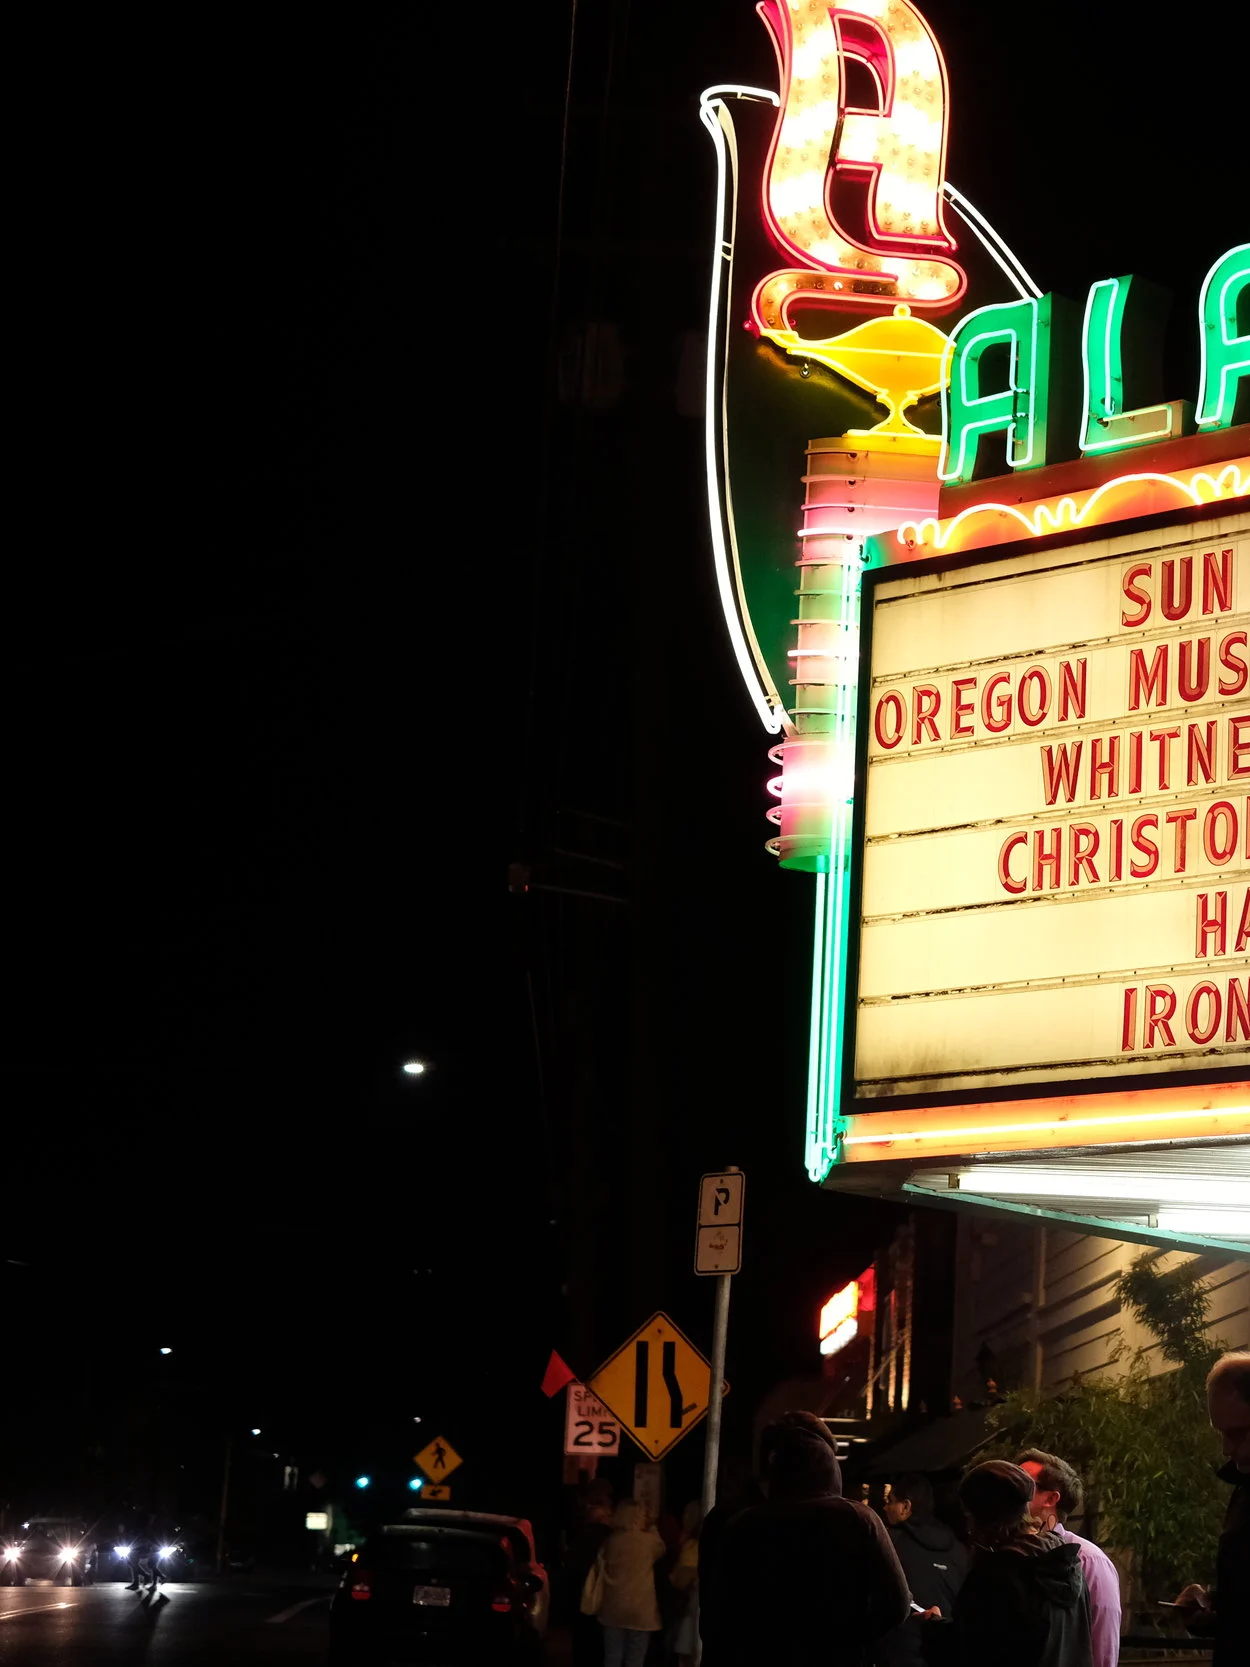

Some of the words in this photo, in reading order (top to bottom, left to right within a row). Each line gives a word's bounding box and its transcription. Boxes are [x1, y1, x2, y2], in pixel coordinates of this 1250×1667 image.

[1121, 549, 1233, 627] SUN
[874, 657, 1087, 750] OREGON
[573, 1420, 617, 1447] 25
